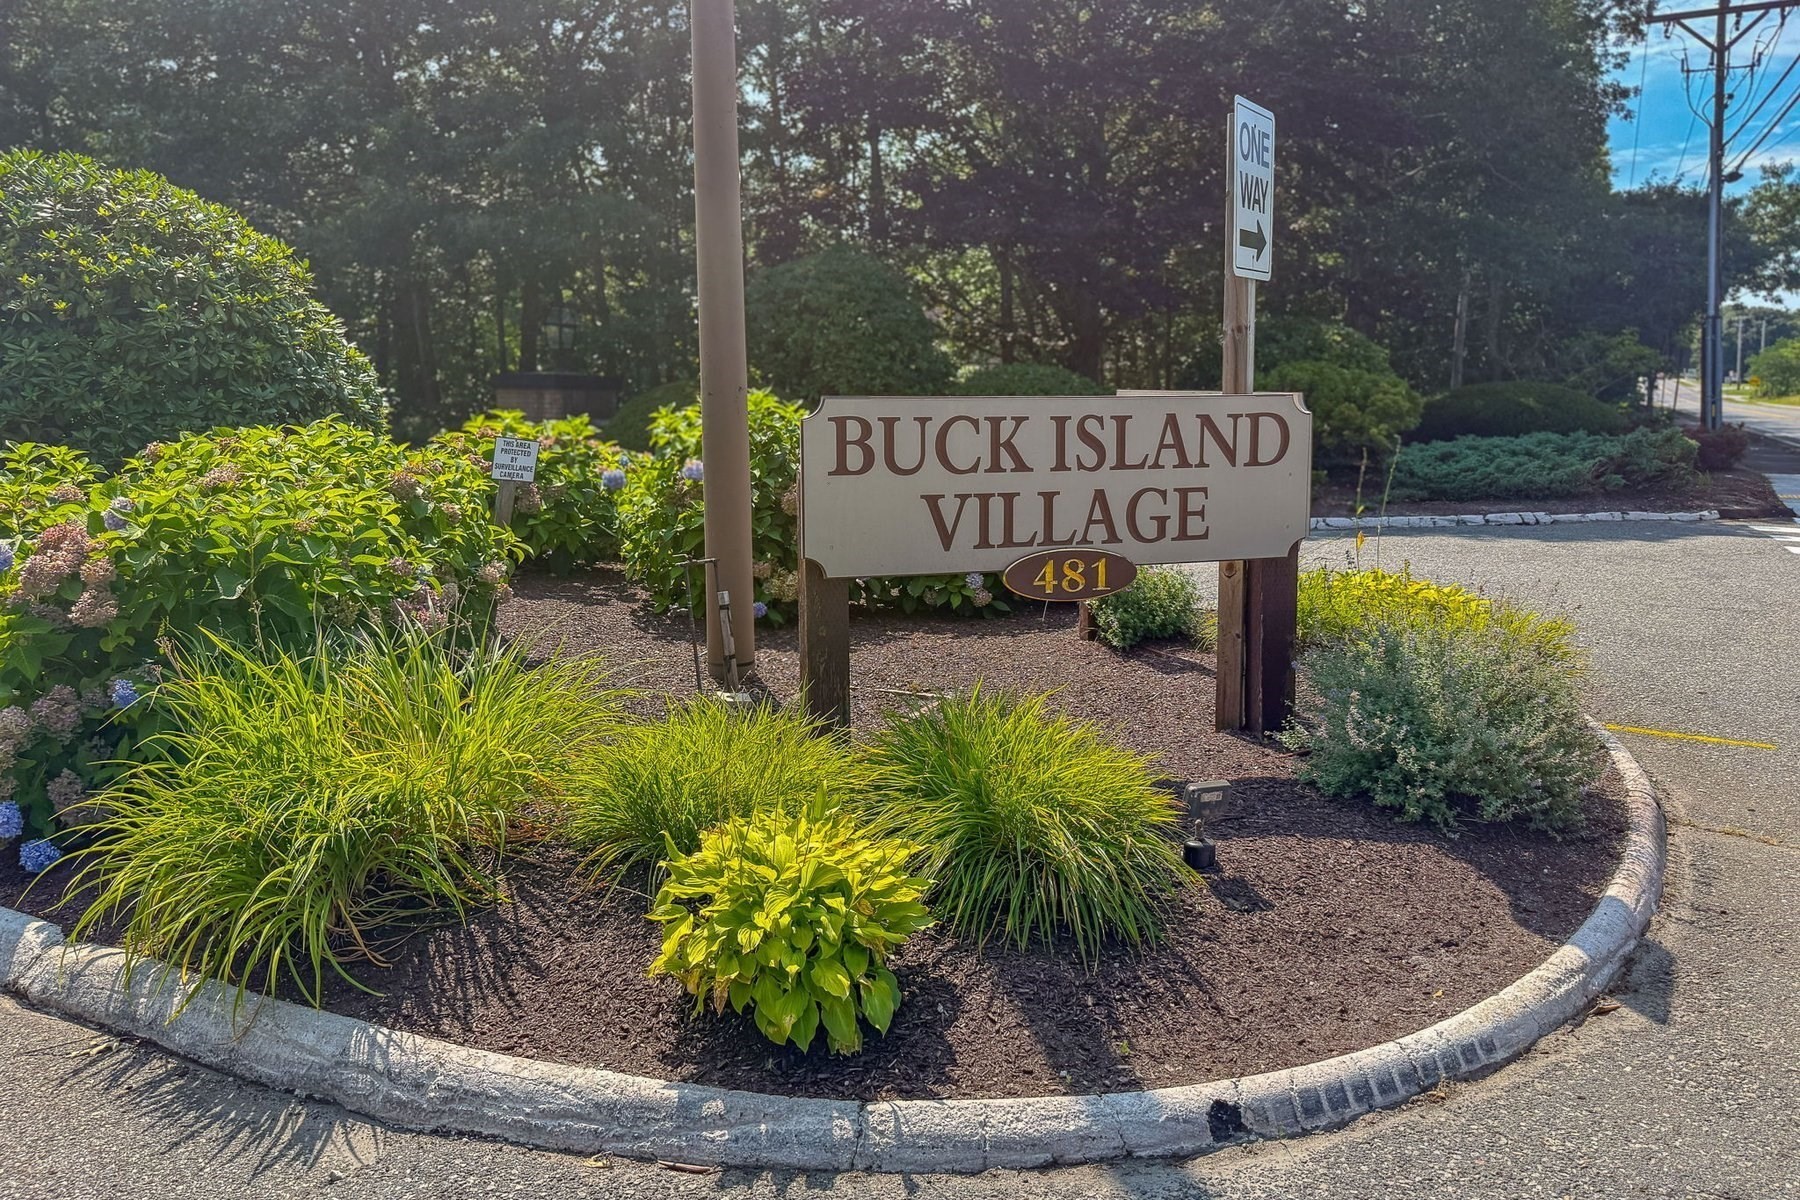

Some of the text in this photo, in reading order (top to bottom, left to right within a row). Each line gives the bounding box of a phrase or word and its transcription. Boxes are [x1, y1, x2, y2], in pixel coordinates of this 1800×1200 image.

[1239, 121, 1270, 169] ONE
[1239, 170, 1269, 214] WAY
[500, 447, 532, 457] PROTECTED
[515, 441, 531, 449] AREA
[827, 411, 1291, 477] BUCK ISLAND
[494, 463, 534, 473] SURVEILLANCE
[510, 456, 518, 464] BY
[499, 471, 524, 479] CAMERA
[920, 486, 1210, 552] VILLAGE
[1033, 557, 1111, 594] 481
